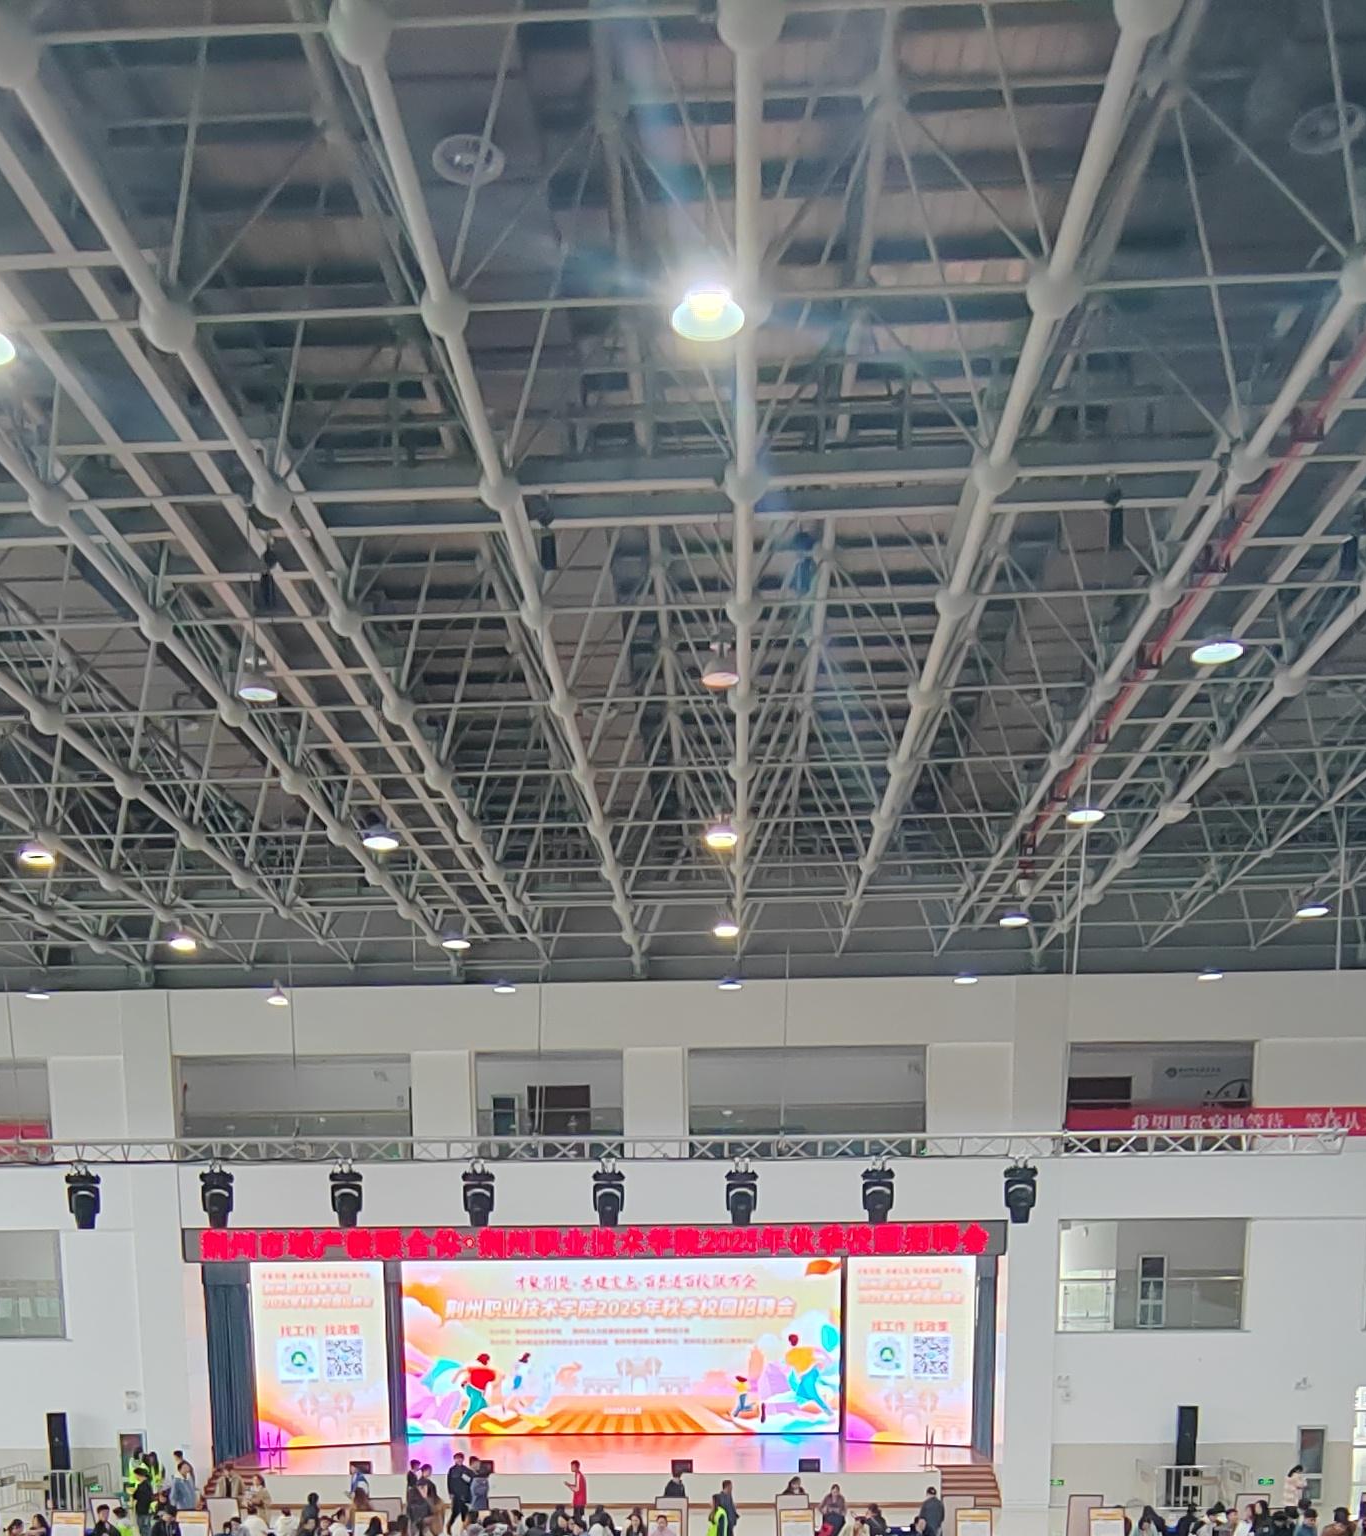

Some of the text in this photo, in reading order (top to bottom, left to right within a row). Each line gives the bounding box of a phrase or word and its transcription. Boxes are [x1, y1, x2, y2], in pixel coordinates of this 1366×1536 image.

[444, 1296, 796, 1319] 荆州职业技术学院2025年秋季校园招聘会
